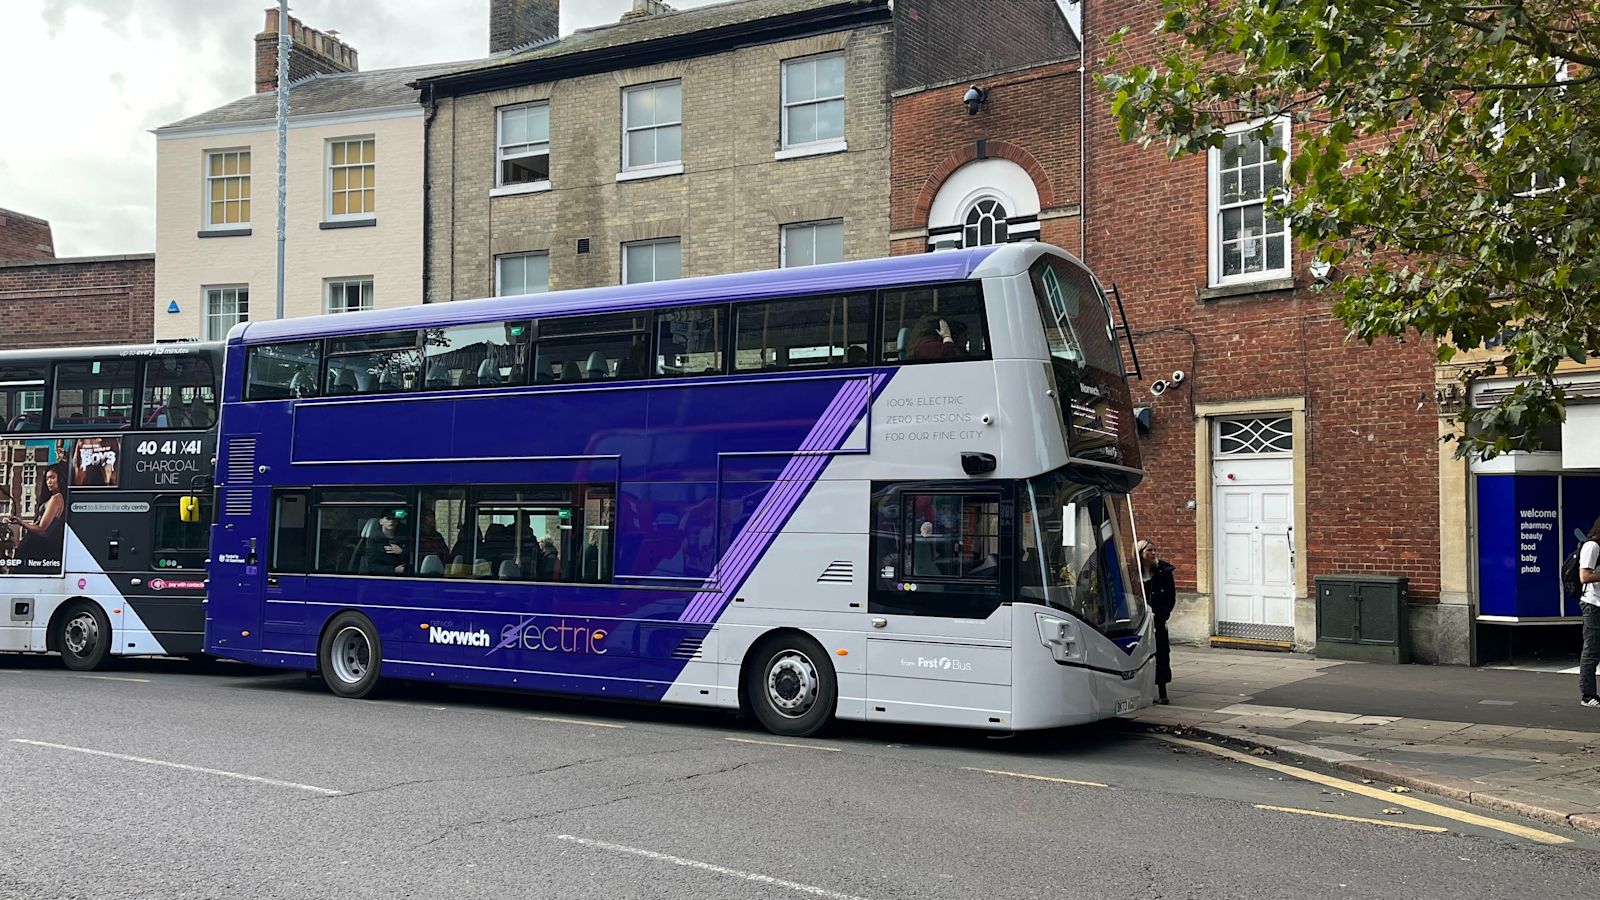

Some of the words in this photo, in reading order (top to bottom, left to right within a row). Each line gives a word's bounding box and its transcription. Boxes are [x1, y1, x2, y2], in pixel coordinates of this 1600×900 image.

[886, 398, 914, 407] 100%
[917, 396, 964, 406] ELECTRIC
[886, 415, 912, 425] ZERO
[916, 413, 972, 424] EMISSIONS
[885, 432, 905, 441] FOR
[908, 432, 929, 441] OUR
[933, 431, 956, 440] FINE
[960, 430, 983, 440] CITY
[136, 440, 158, 455] 40
[160, 440, 177, 454] 41
[179, 440, 201, 454] X41
[136, 460, 199, 472] CHARCOAL
[155, 472, 179, 485] LINE
[1520, 508, 1557, 518] welcome
[1520, 522, 1552, 530] pharmacy
[1521, 532, 1543, 541] beauty
[6, 559, 22, 567] SEP
[42, 559, 60, 567] Series
[1521, 554, 1537, 563] baby
[1521, 565, 1541, 574] photo
[429, 626, 490, 647] Norwich
[500, 614, 608, 655] electric
[918, 657, 938, 669] First
[952, 659, 972, 671] Bus
